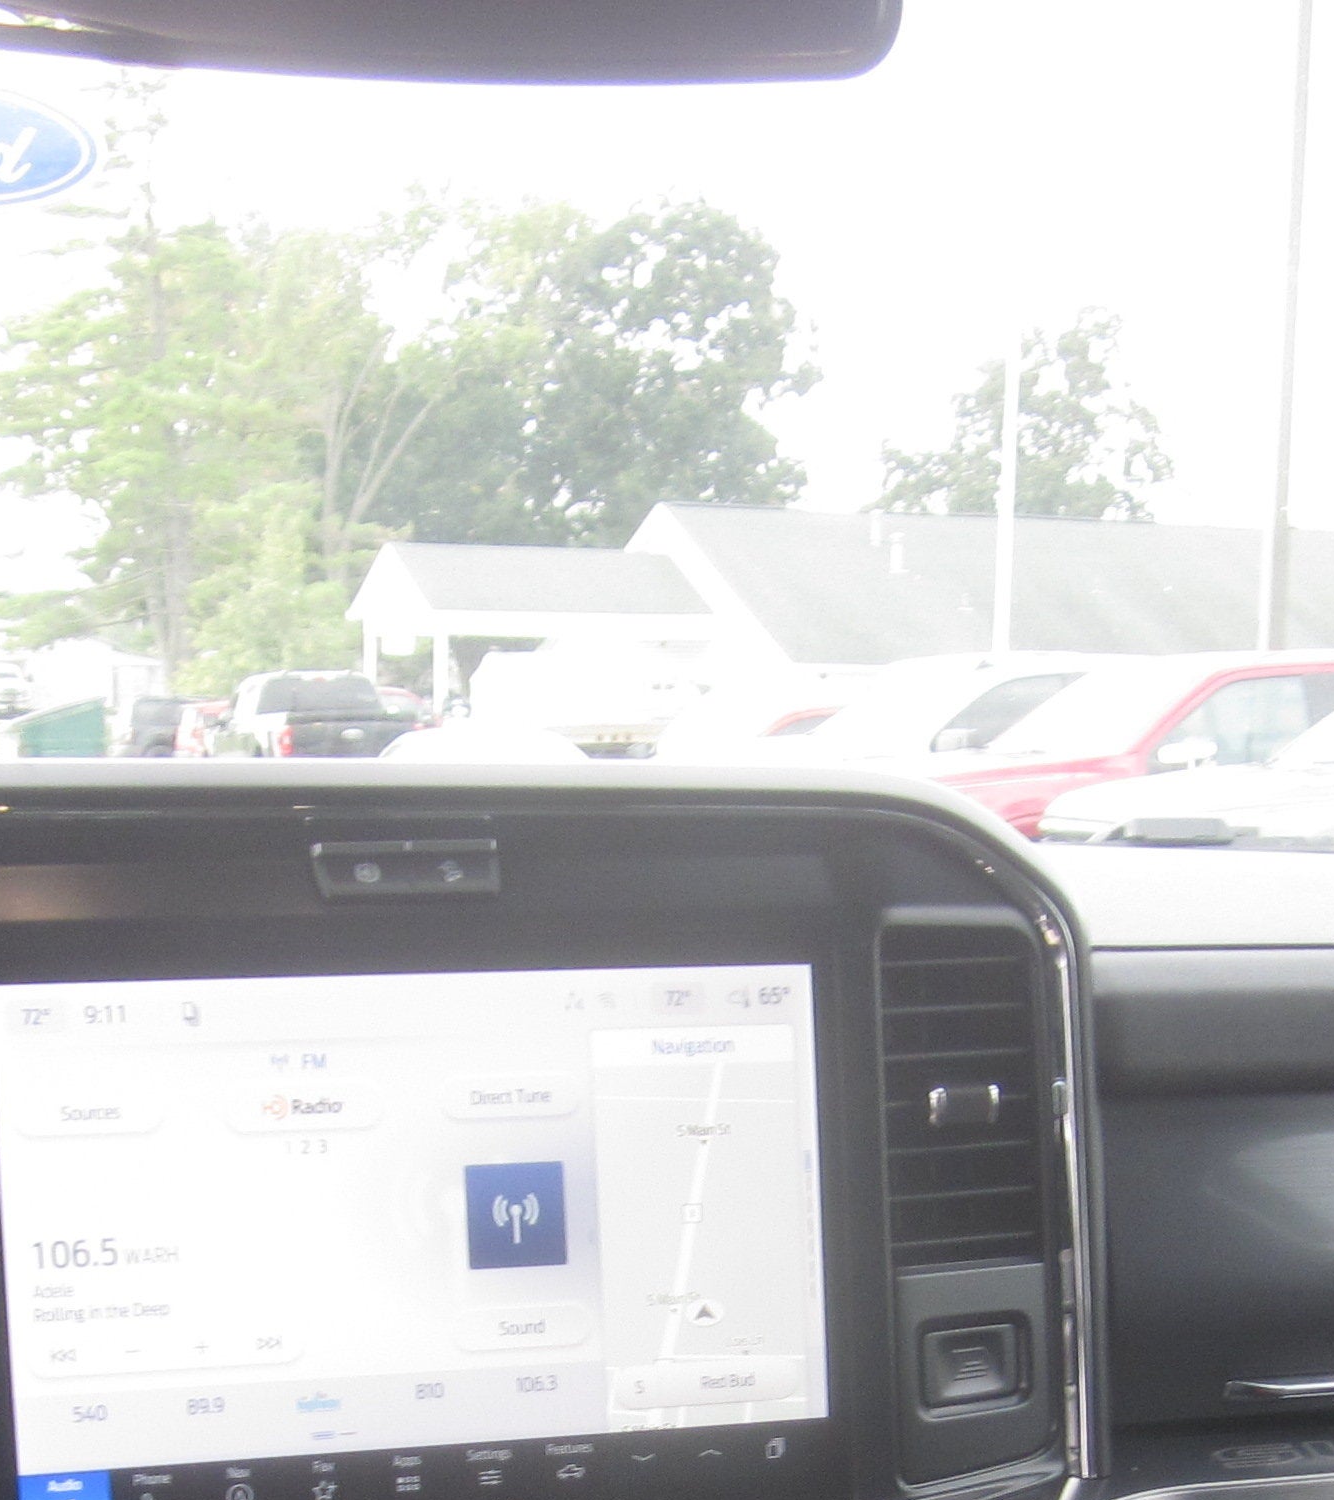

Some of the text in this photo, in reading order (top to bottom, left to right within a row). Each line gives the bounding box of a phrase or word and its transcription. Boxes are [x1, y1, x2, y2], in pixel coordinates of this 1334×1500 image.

[83, 1004, 126, 1024] 9:11
[651, 1038, 735, 1056] Navigation
[301, 1054, 327, 1069] FM
[515, 1089, 552, 1103] Tune
[61, 1105, 122, 1121] Sources
[291, 1099, 344, 1115] Radio
[33, 1238, 118, 1270] 106.5
[498, 1319, 546, 1335] Sound
[72, 1405, 108, 1422] 540
[47, 1479, 83, 1492] Audio
